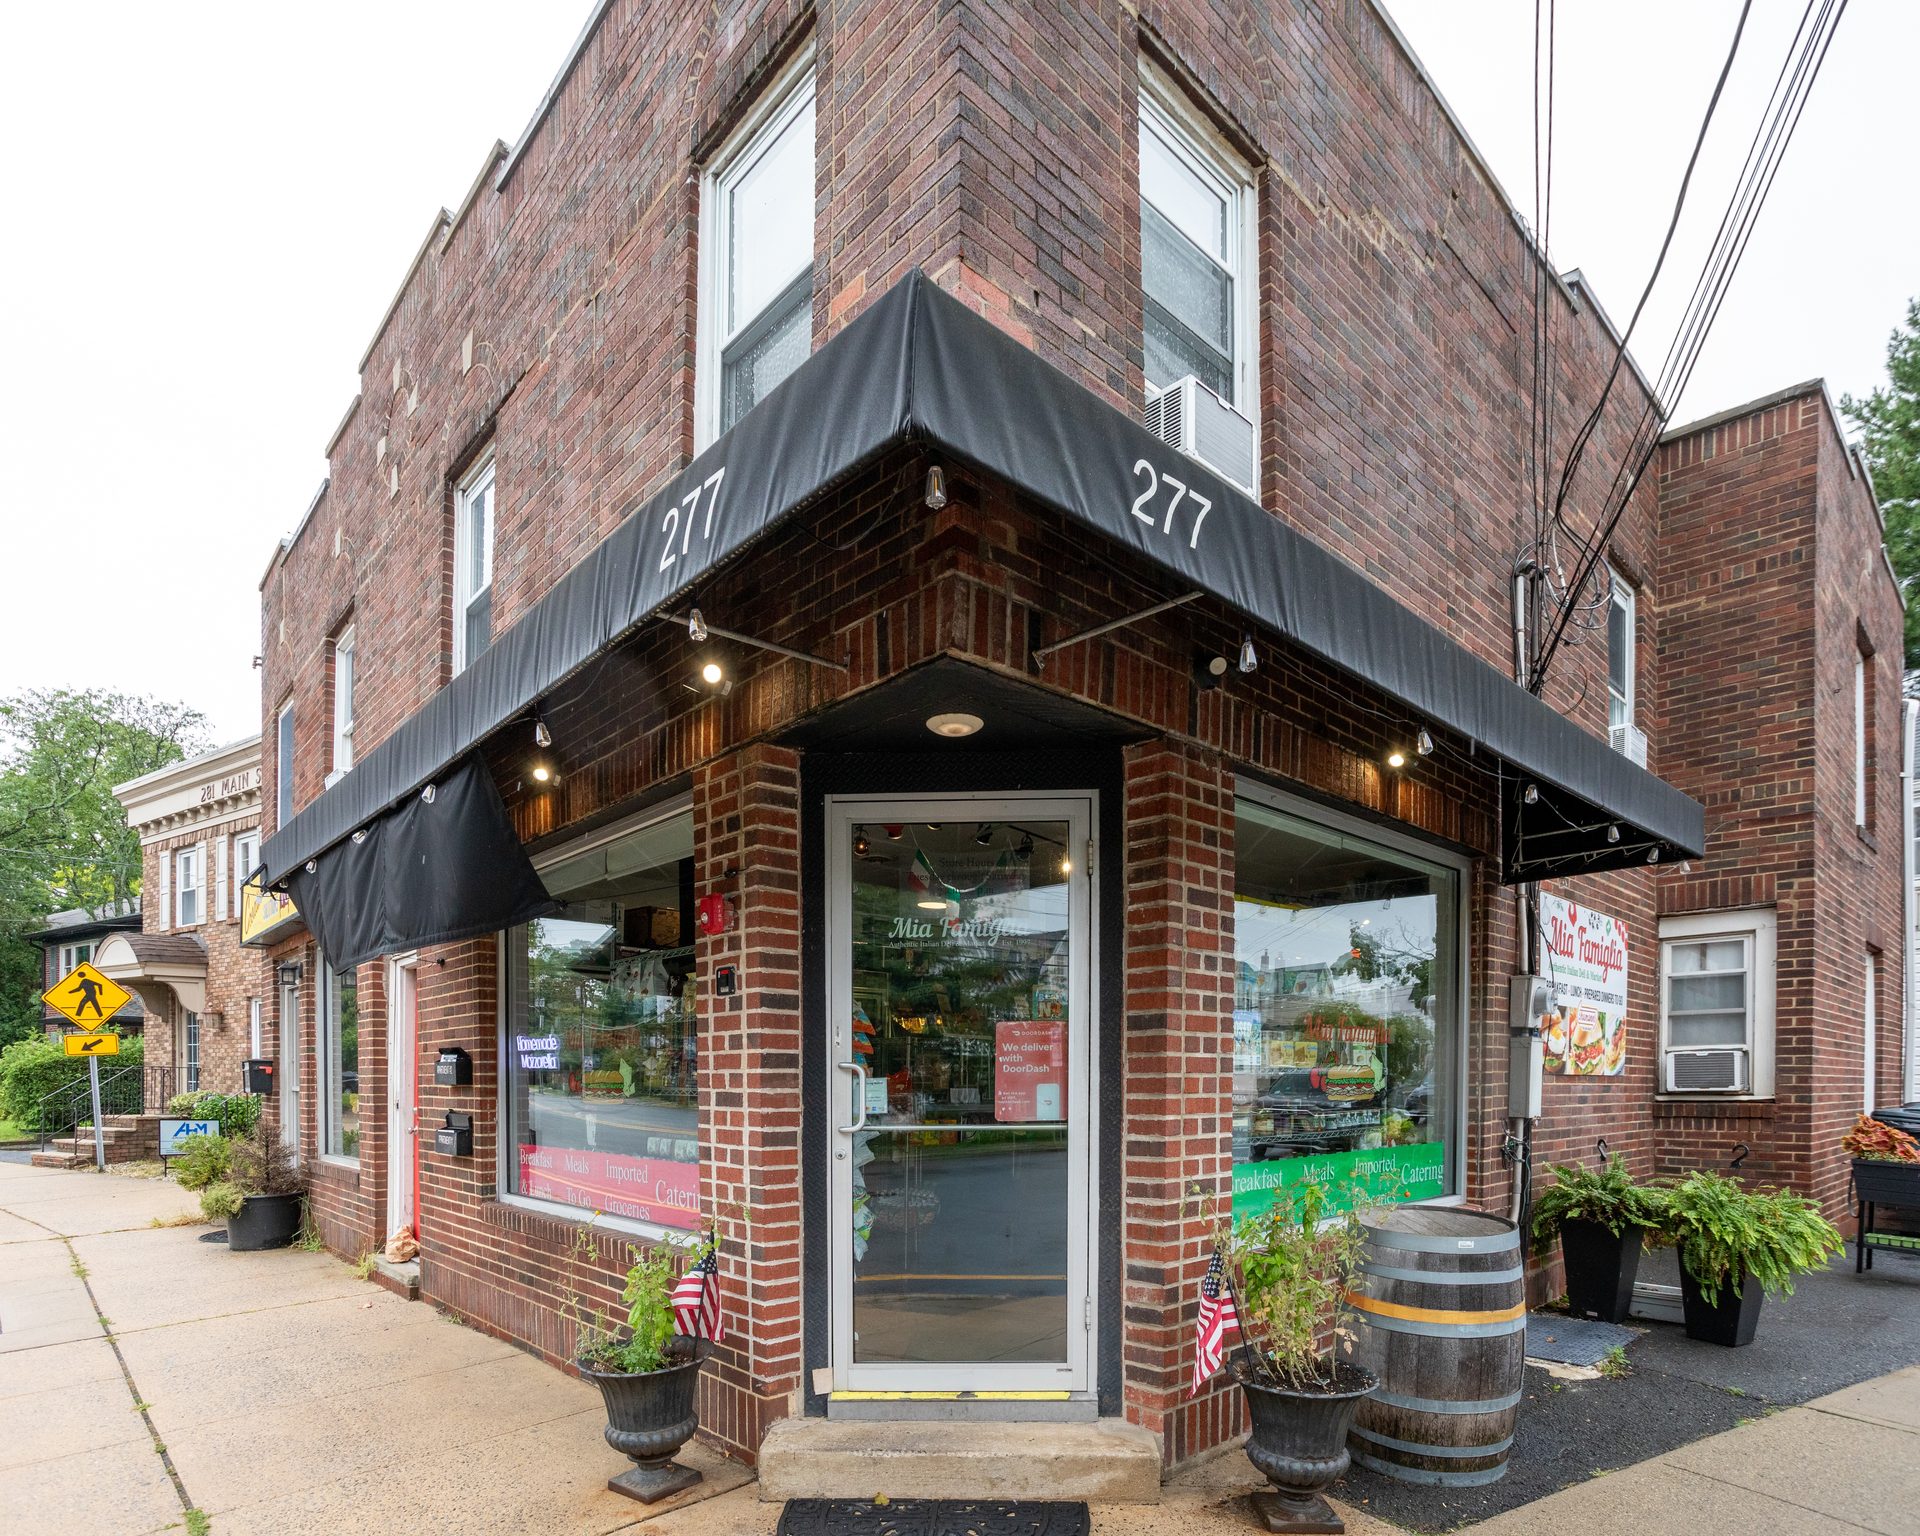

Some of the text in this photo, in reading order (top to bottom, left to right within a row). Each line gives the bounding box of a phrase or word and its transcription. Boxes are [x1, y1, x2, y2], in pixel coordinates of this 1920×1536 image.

[1131, 459, 1212, 549] 277
[659, 466, 726, 573] 277
[200, 783, 215, 803] 281
[221, 772, 249, 796] MAIN
[888, 917, 933, 939] Mia
[1548, 916, 1624, 984] Mia Famiglia
[1002, 1042, 1053, 1052] We deliver
[1001, 1054, 1023, 1063] with
[1003, 1064, 1049, 1073] DoorDash
[520, 1148, 553, 1169] Breakfast
[564, 1154, 591, 1175] Meals
[1355, 1153, 1397, 1175] Imported
[606, 1160, 649, 1184] Imported
[1303, 1161, 1335, 1182] Meals
[1401, 1163, 1444, 1186] Catering
[522, 1179, 552, 1200] & Lunch
[566, 1187, 592, 1208] To Go
[604, 1194, 650, 1221] Groceries
